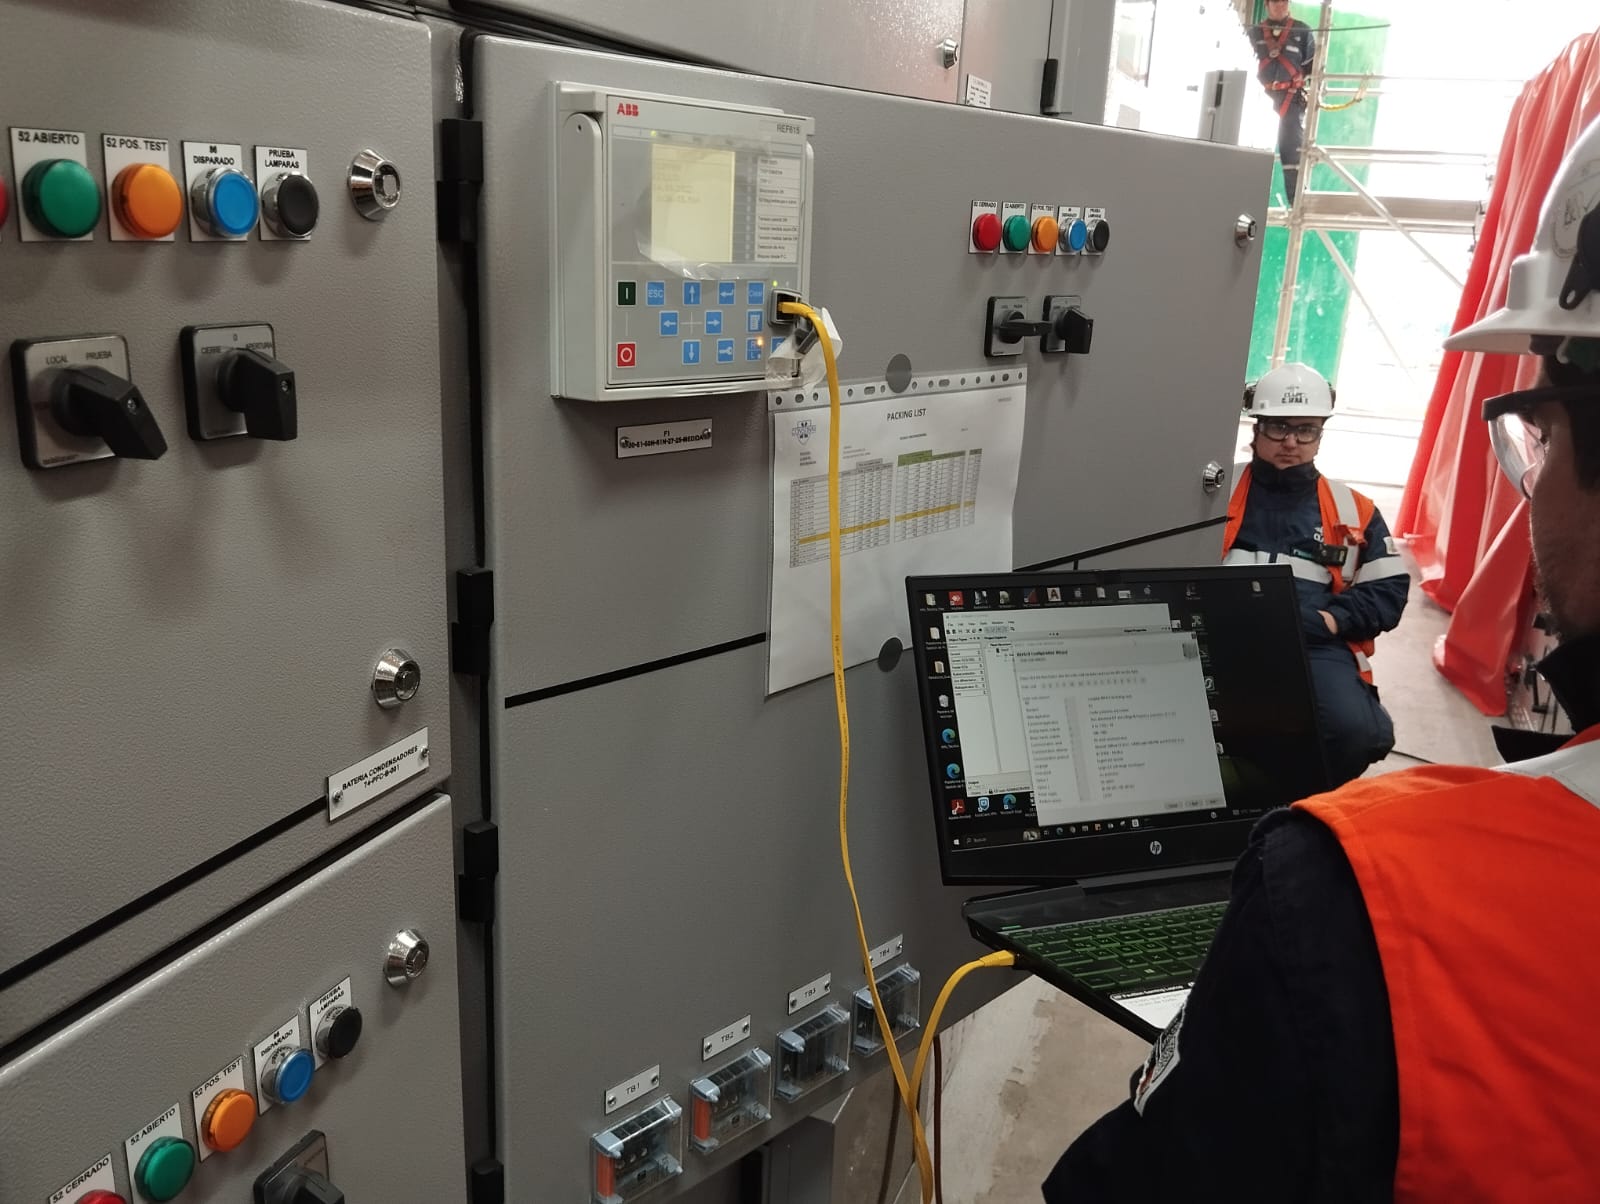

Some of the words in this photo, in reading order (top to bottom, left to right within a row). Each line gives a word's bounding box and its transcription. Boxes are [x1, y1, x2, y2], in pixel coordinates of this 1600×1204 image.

[617, 103, 639, 117] ABB
[776, 124, 800, 134] REF615
[18, 131, 30, 142] 52
[33, 132, 79, 145] ABIERTO
[106, 137, 117, 148] 52
[119, 138, 141, 150] POS.
[143, 140, 168, 151] TEST
[193, 155, 235, 165] DISPARADO
[268, 149, 295, 158] PRUEBA
[264, 160, 299, 169] LAMPARAS
[648, 288, 664, 298] ESC
[46, 354, 68, 365] LOCAL
[86, 350, 112, 360] PRUEBA
[887, 409, 913, 421] PACKING
[914, 408, 927, 417] LIST
[342, 772, 368, 791] BATERIA
[368, 745, 418, 776] CONDENSADORES
[804, 987, 816, 998] TB3
[261, 1029, 293, 1056] DISPARADO
[721, 1031, 734, 1043] TB2
[194, 1087, 203, 1098] 52
[204, 1075, 222, 1091] POS.
[223, 1060, 241, 1076] TEST
[626, 1081, 640, 1095] TB1
[130, 1134, 140, 1146] 52
[140, 1108, 176, 1139] ABIERTO
[52, 1190, 64, 1203] 52
[65, 1157, 110, 1194] CERRADO
